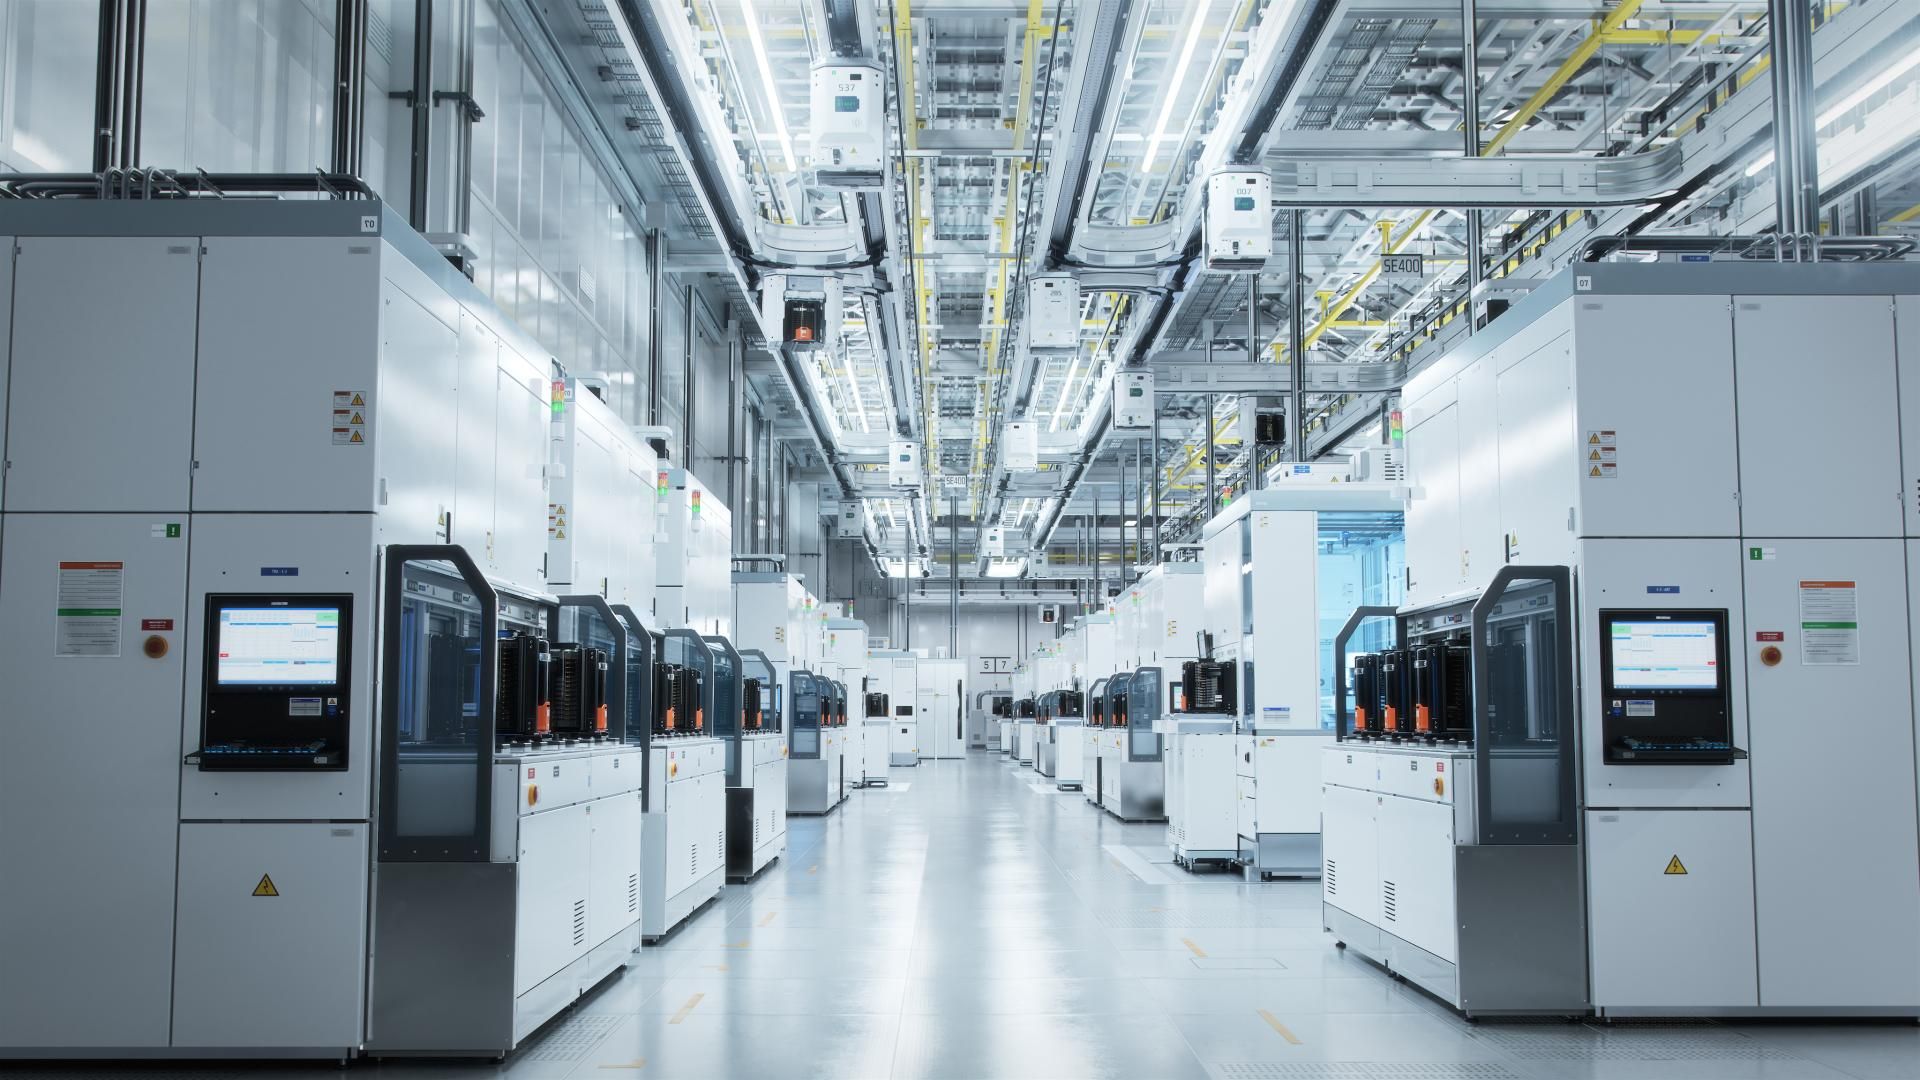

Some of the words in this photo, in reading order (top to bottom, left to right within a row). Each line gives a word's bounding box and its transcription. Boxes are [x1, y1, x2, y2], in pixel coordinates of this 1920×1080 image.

[838, 84, 855, 92] 537
[1384, 259, 1419, 272] SE400
[1580, 279, 1588, 287] 07
[946, 476, 965, 484] SE400
[984, 660, 989, 669] 5
[1001, 660, 1007, 669] 7
